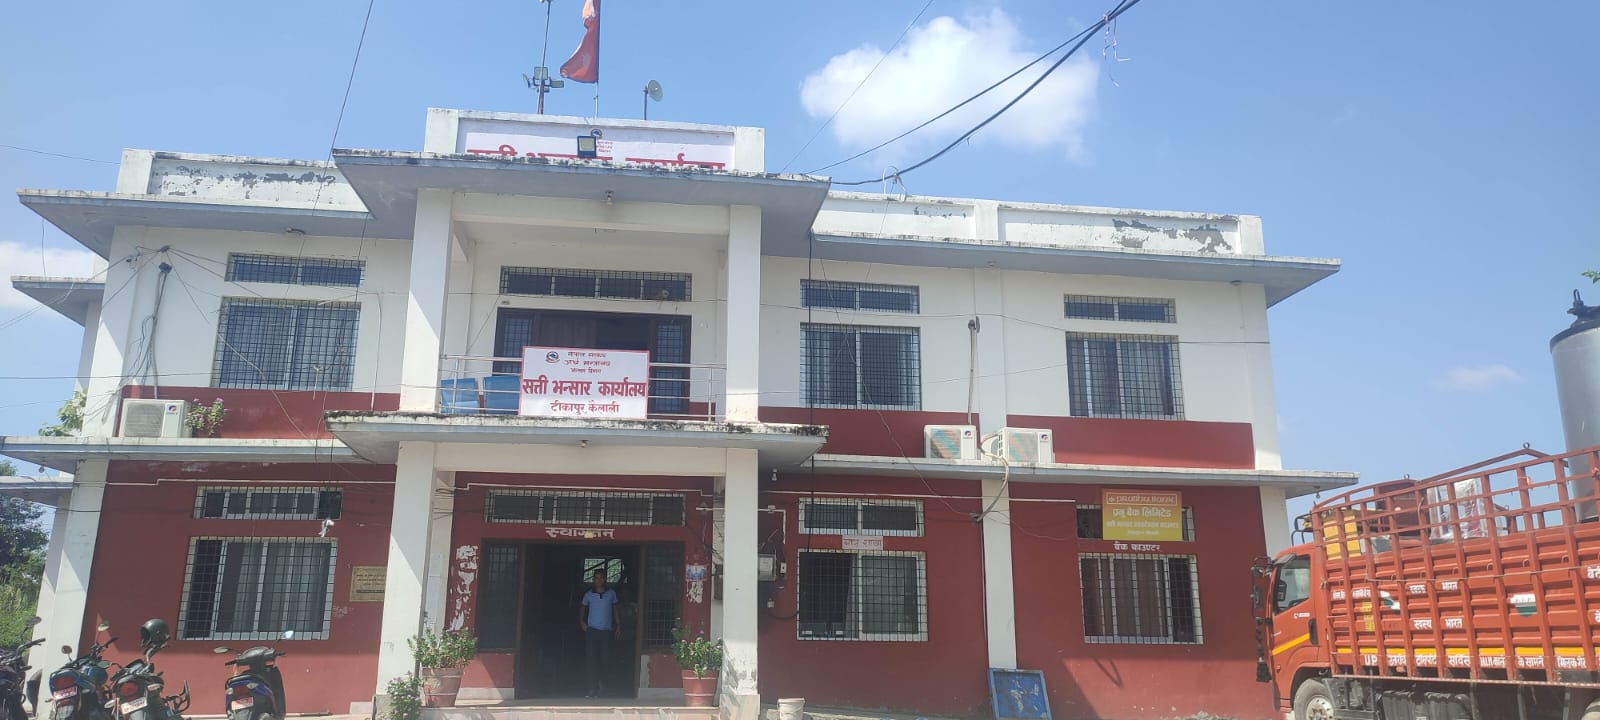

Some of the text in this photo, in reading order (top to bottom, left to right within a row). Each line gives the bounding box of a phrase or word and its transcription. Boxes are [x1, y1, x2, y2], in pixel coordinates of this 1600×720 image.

[522, 375, 647, 397] सत्ती भन्सार कार्यालय
[588, 400, 621, 413] कैलाली
